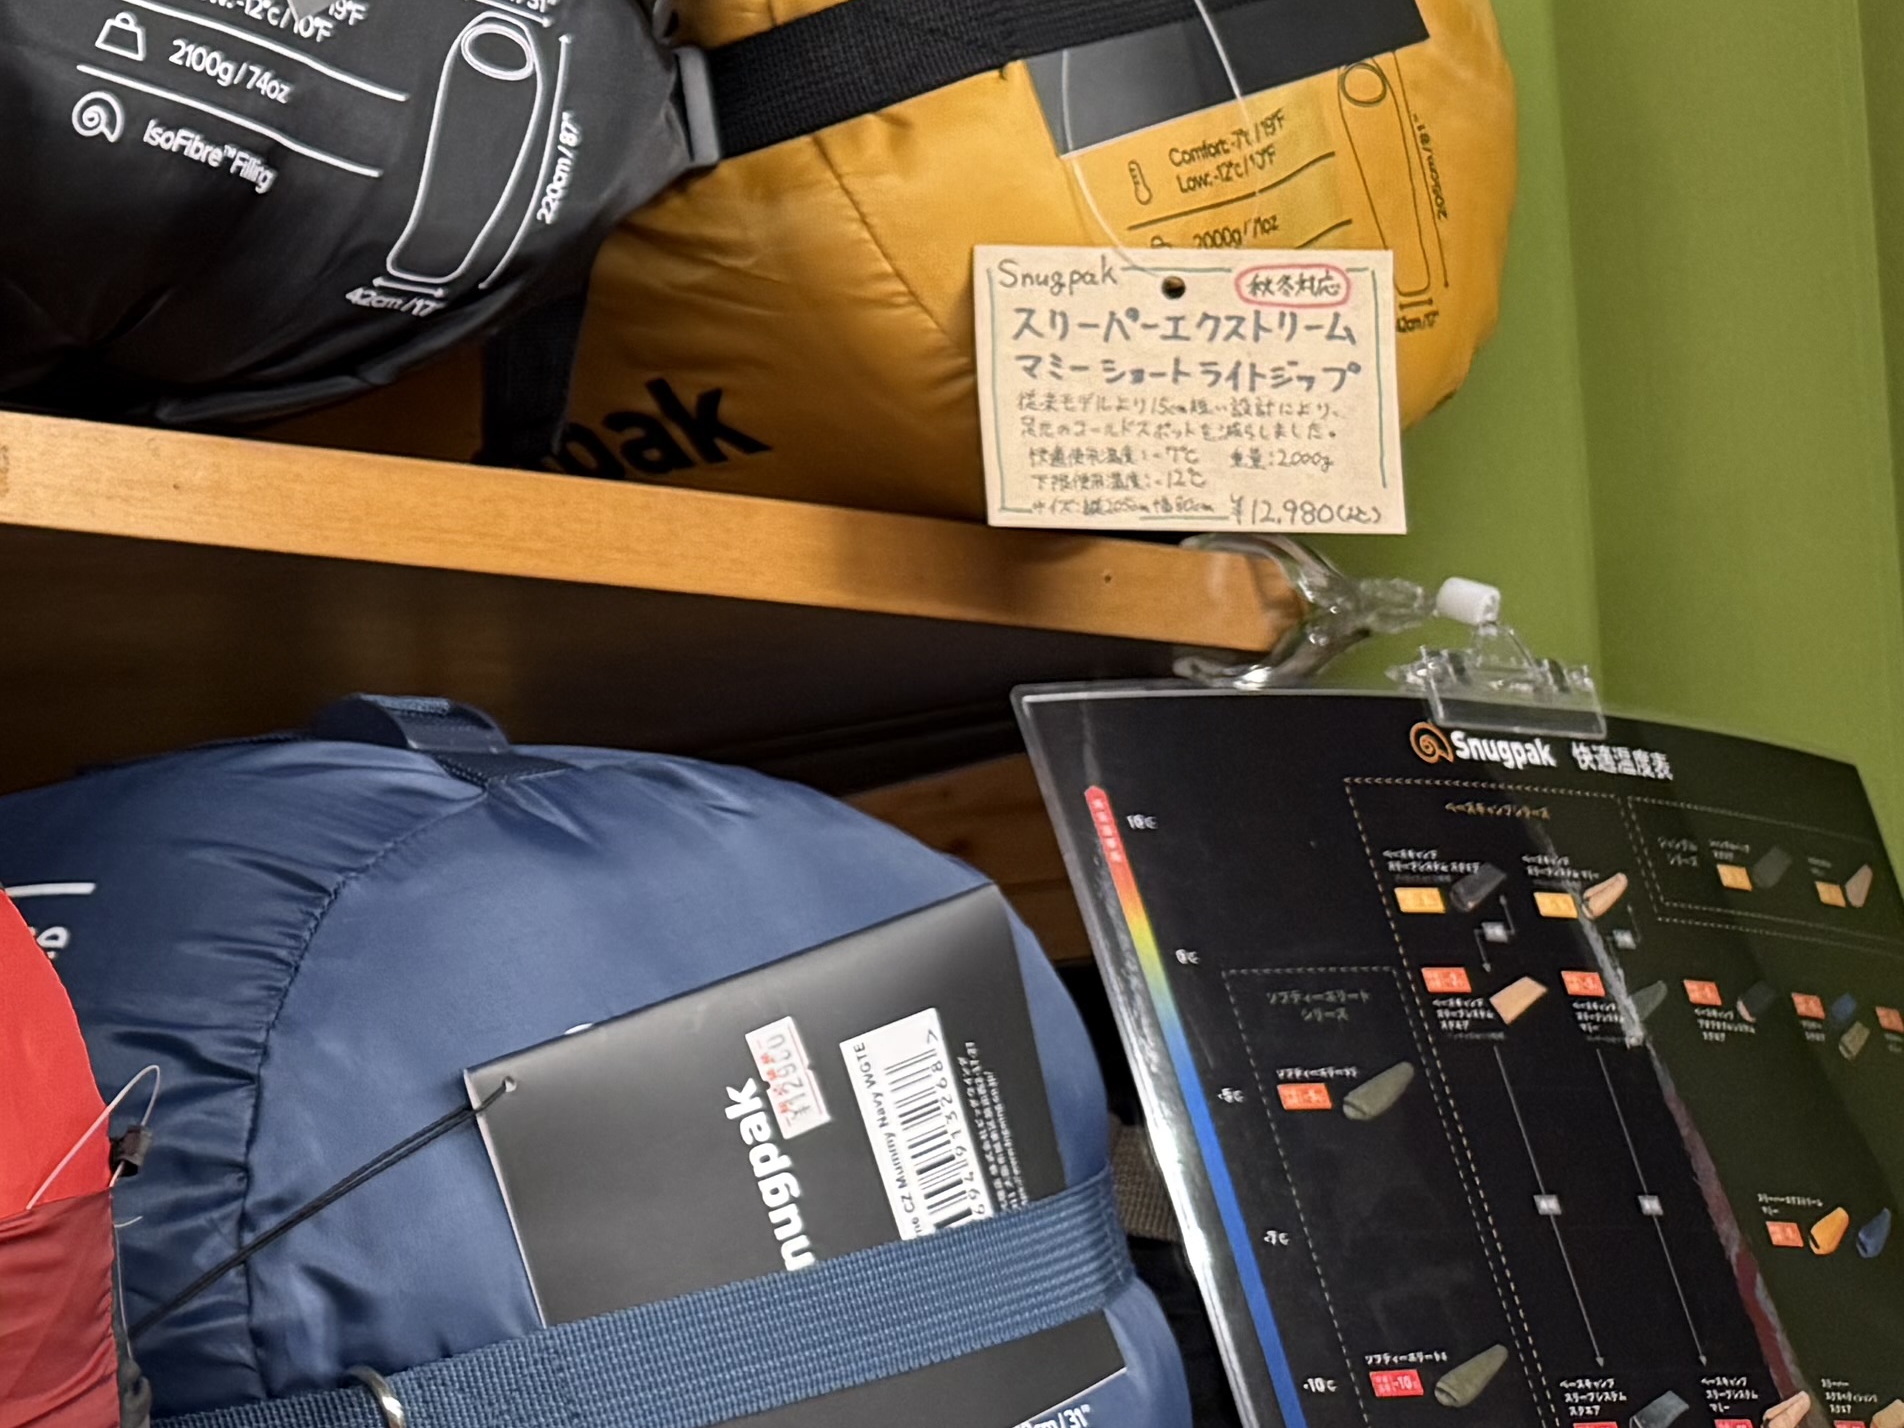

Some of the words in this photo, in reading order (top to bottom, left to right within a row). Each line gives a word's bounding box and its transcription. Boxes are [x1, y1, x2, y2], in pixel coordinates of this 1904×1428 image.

[998, 255, 1120, 299] Snugpak
[1450, 732, 1557, 770] Snugpak
[853, 1041, 874, 1089] WGTE
[871, 1089, 889, 1129] Navy
[725, 1077, 817, 1272] nugpak
[884, 1132, 908, 1189] Mummy
